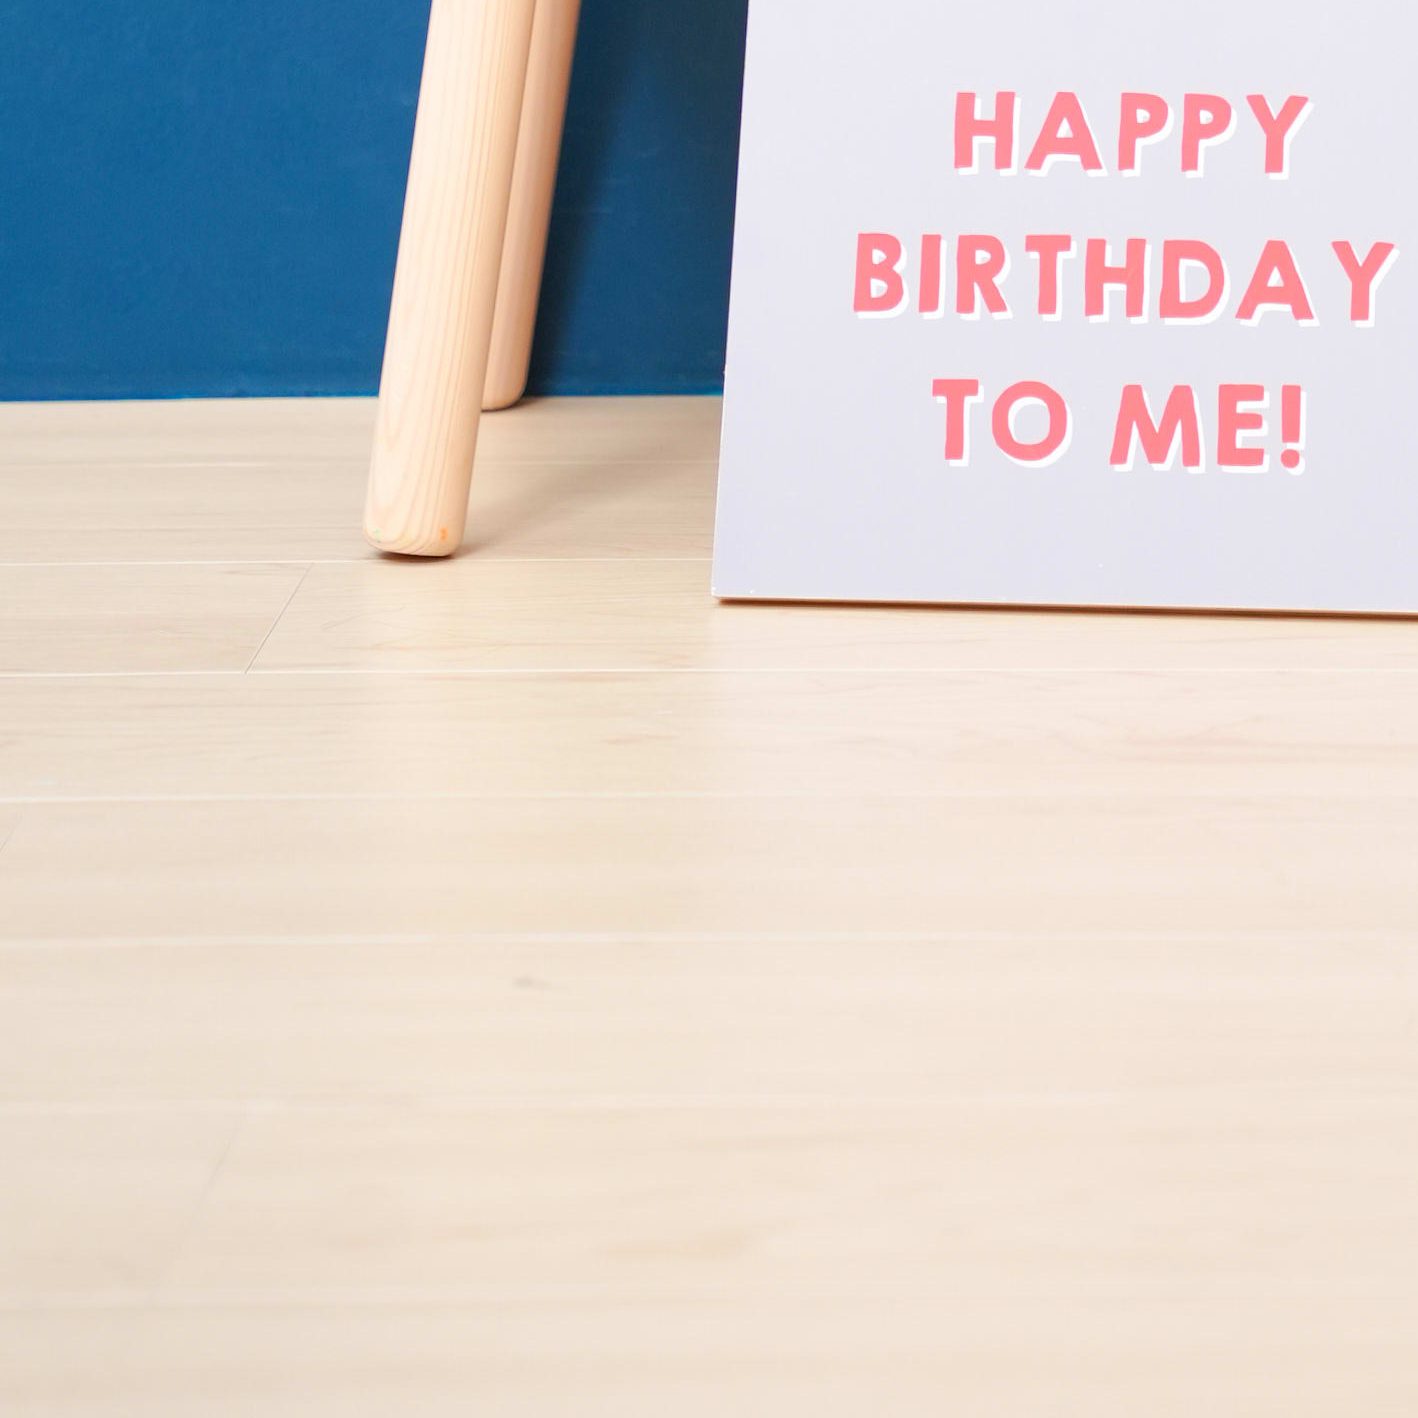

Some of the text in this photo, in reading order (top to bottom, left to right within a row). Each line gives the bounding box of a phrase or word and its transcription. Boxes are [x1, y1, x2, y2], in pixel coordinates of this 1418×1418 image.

[953, 91, 1312, 177] HAPPY
[852, 233, 1399, 326] BIRTHDAY
[931, 378, 1306, 474] TO ME!
